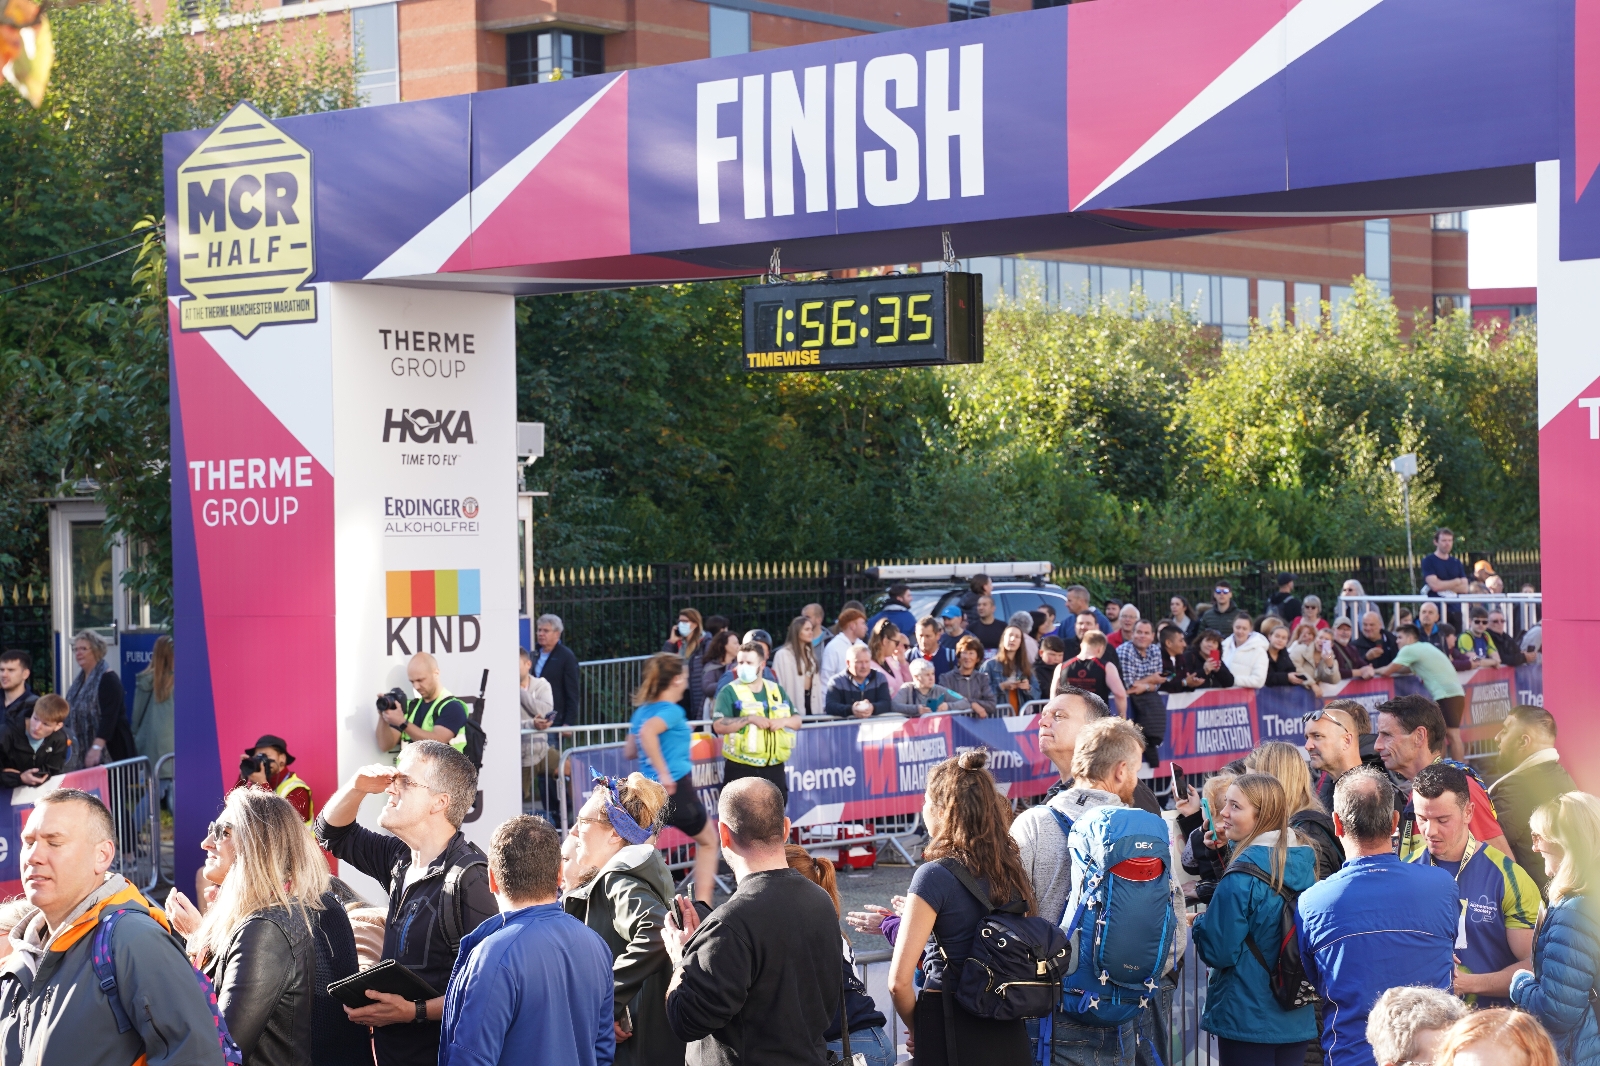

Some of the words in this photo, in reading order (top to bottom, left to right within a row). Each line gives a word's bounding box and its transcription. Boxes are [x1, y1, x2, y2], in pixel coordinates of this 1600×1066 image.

[697, 43, 985, 225] FINISH
[187, 171, 300, 235] MCR
[207, 235, 281, 268] HALF
[185, 308, 193, 320] AT
[193, 306, 204, 320] THE
[205, 304, 229, 319] THERME
[230, 301, 273, 317] MANCHESTER
[273, 298, 310, 314] MARATHON
[776, 294, 932, 348] 1:56:35
[379, 329, 475, 354] THERME
[391, 357, 466, 378] GROUP
[747, 350, 820, 368] TIMEWISE
[382, 408, 474, 444] HOKA
[401, 454, 425, 465] TIME
[427, 454, 440, 466] TO
[442, 454, 457, 466] FLY
[189, 456, 312, 491] THERME
[202, 496, 298, 527] GROUP
[384, 497, 461, 518] ERDINGER
[384, 521, 479, 533] ALKOHOLFREI
[386, 615, 481, 656] KIND
[1472, 682, 1509, 703] MANCHESTER
[1197, 706, 1249, 729] MANCHESTER
[898, 737, 947, 763] MANCHESTER
[1197, 726, 1253, 754] MARATHON
